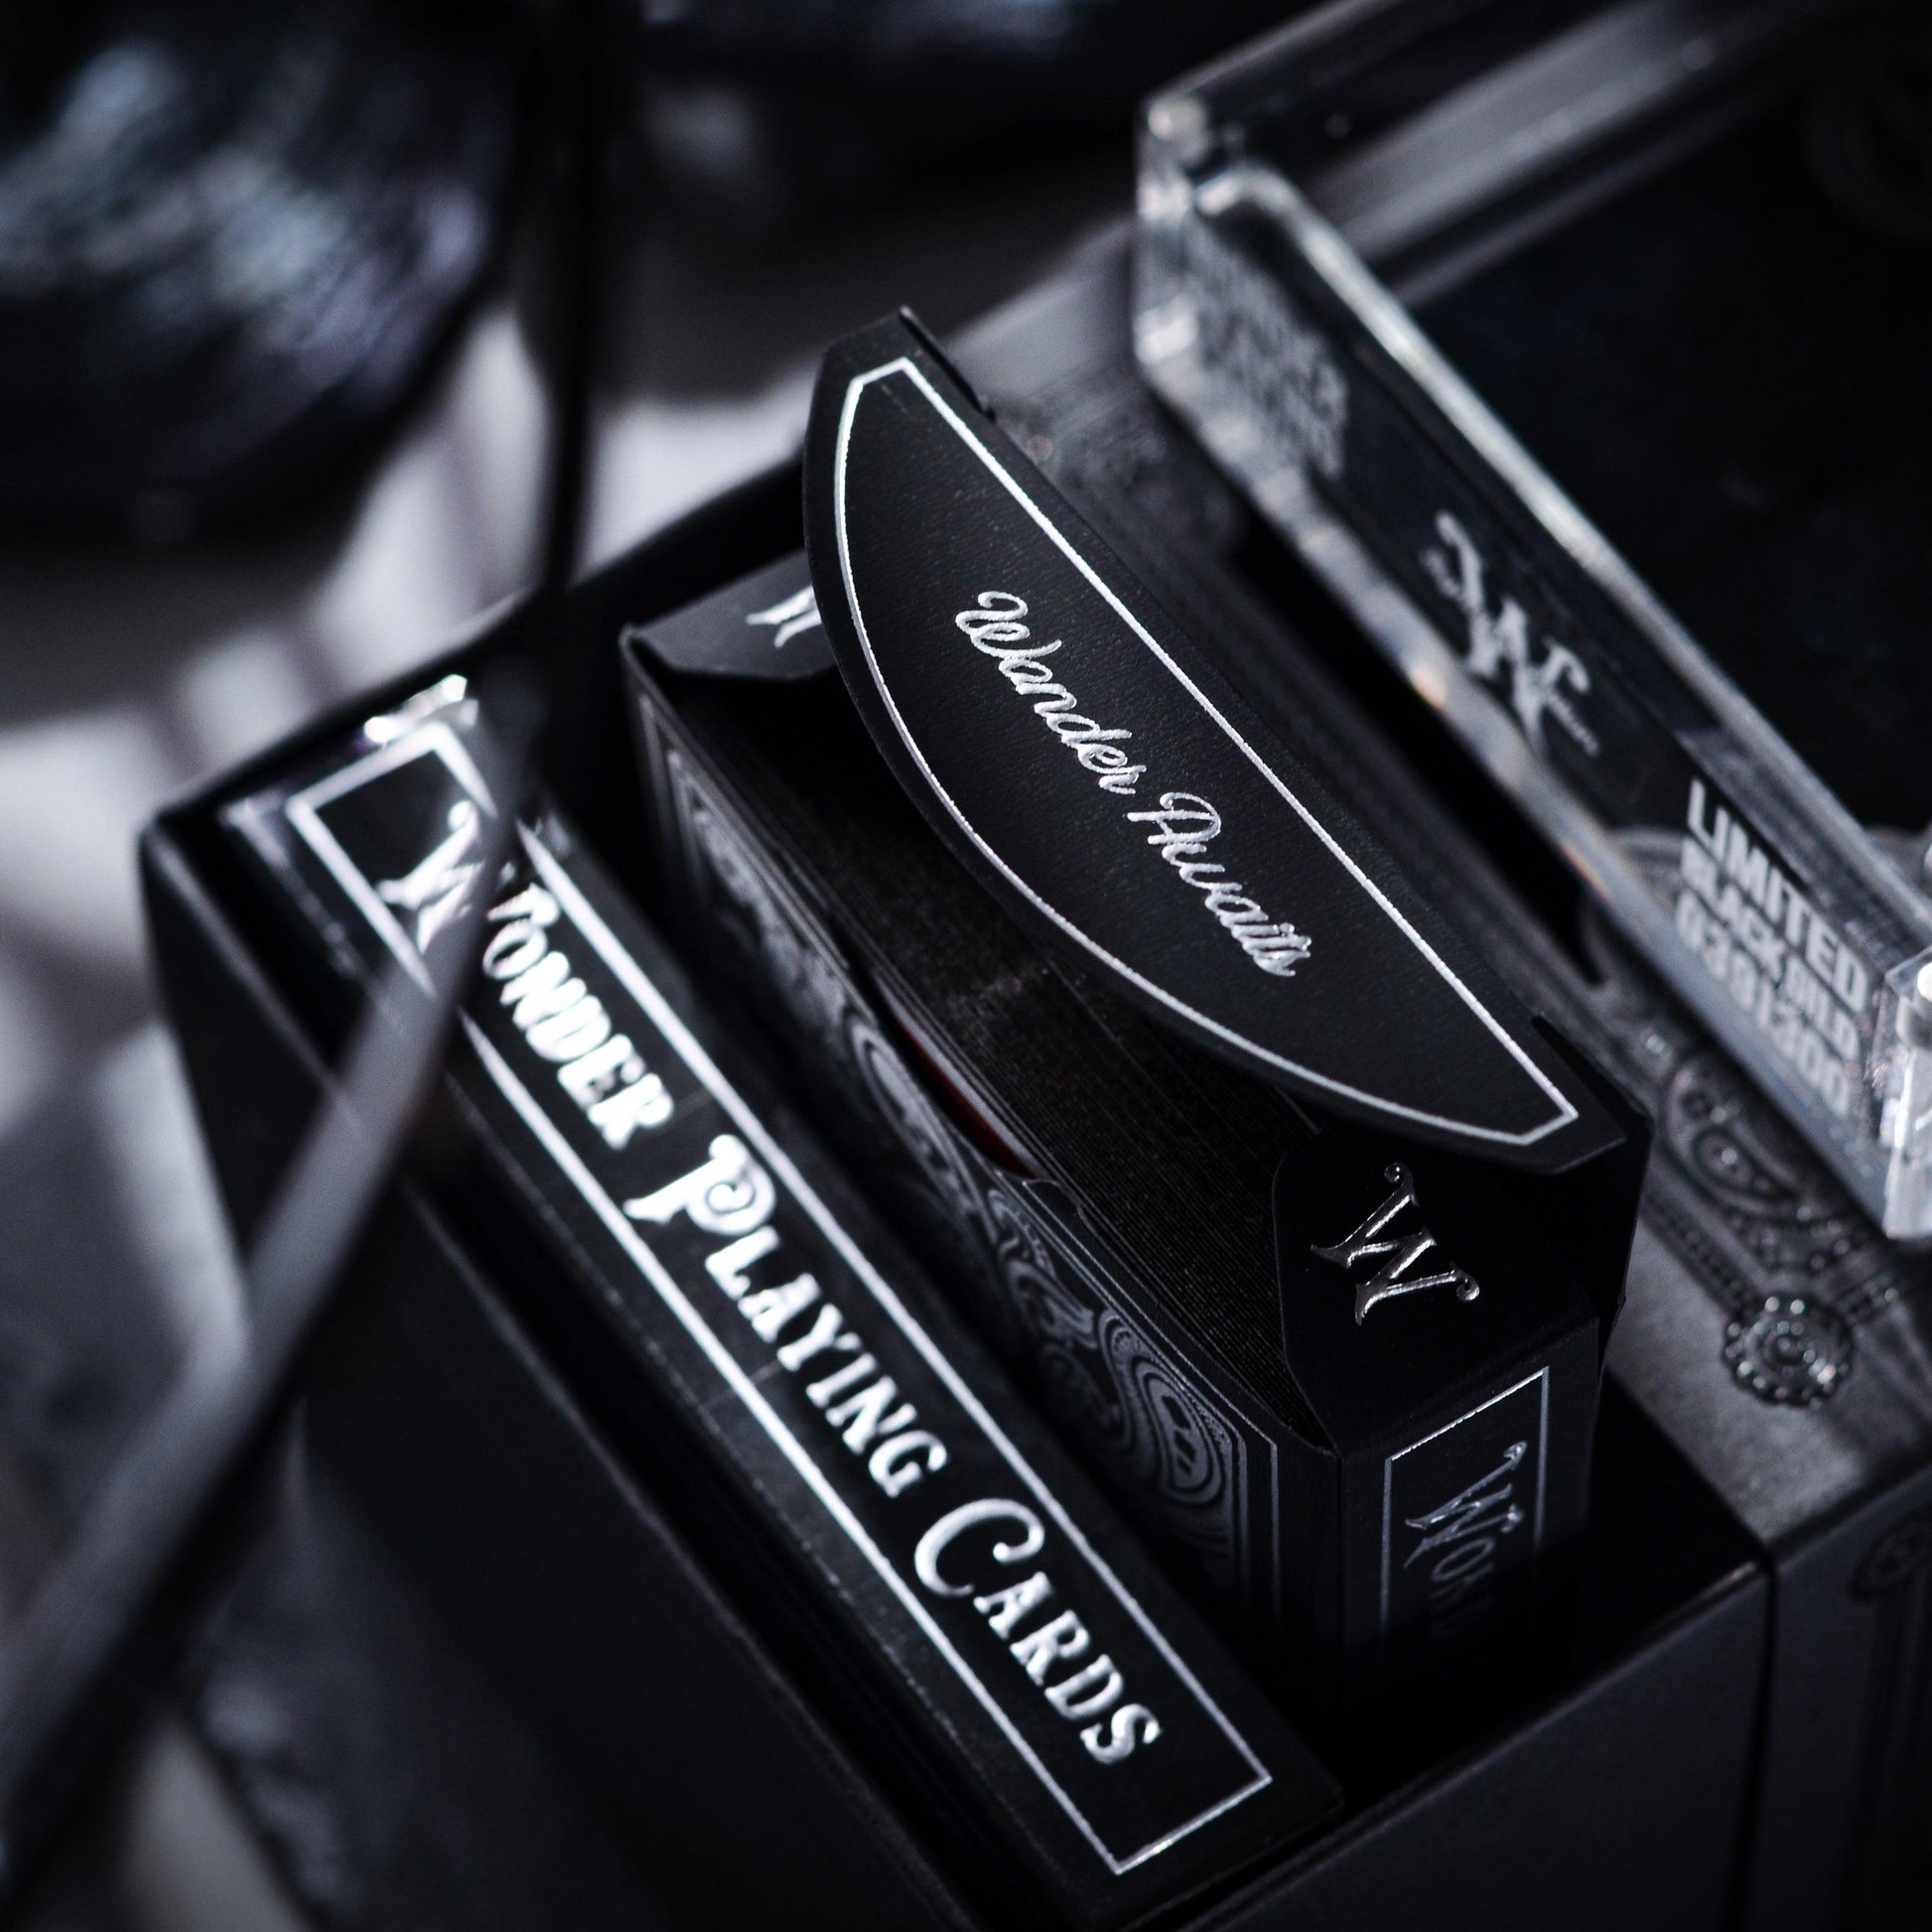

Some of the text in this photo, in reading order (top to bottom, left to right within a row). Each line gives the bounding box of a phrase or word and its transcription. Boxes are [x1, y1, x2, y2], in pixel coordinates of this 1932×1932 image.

[955, 590, 1312, 977] Wonder Awaits
[1687, 777, 1869, 1015] LIMITED
[1310, 1162, 1481, 1326] W
[623, 1133, 948, 1499] PLAYING
[912, 1496, 1165, 1767] CARDS
